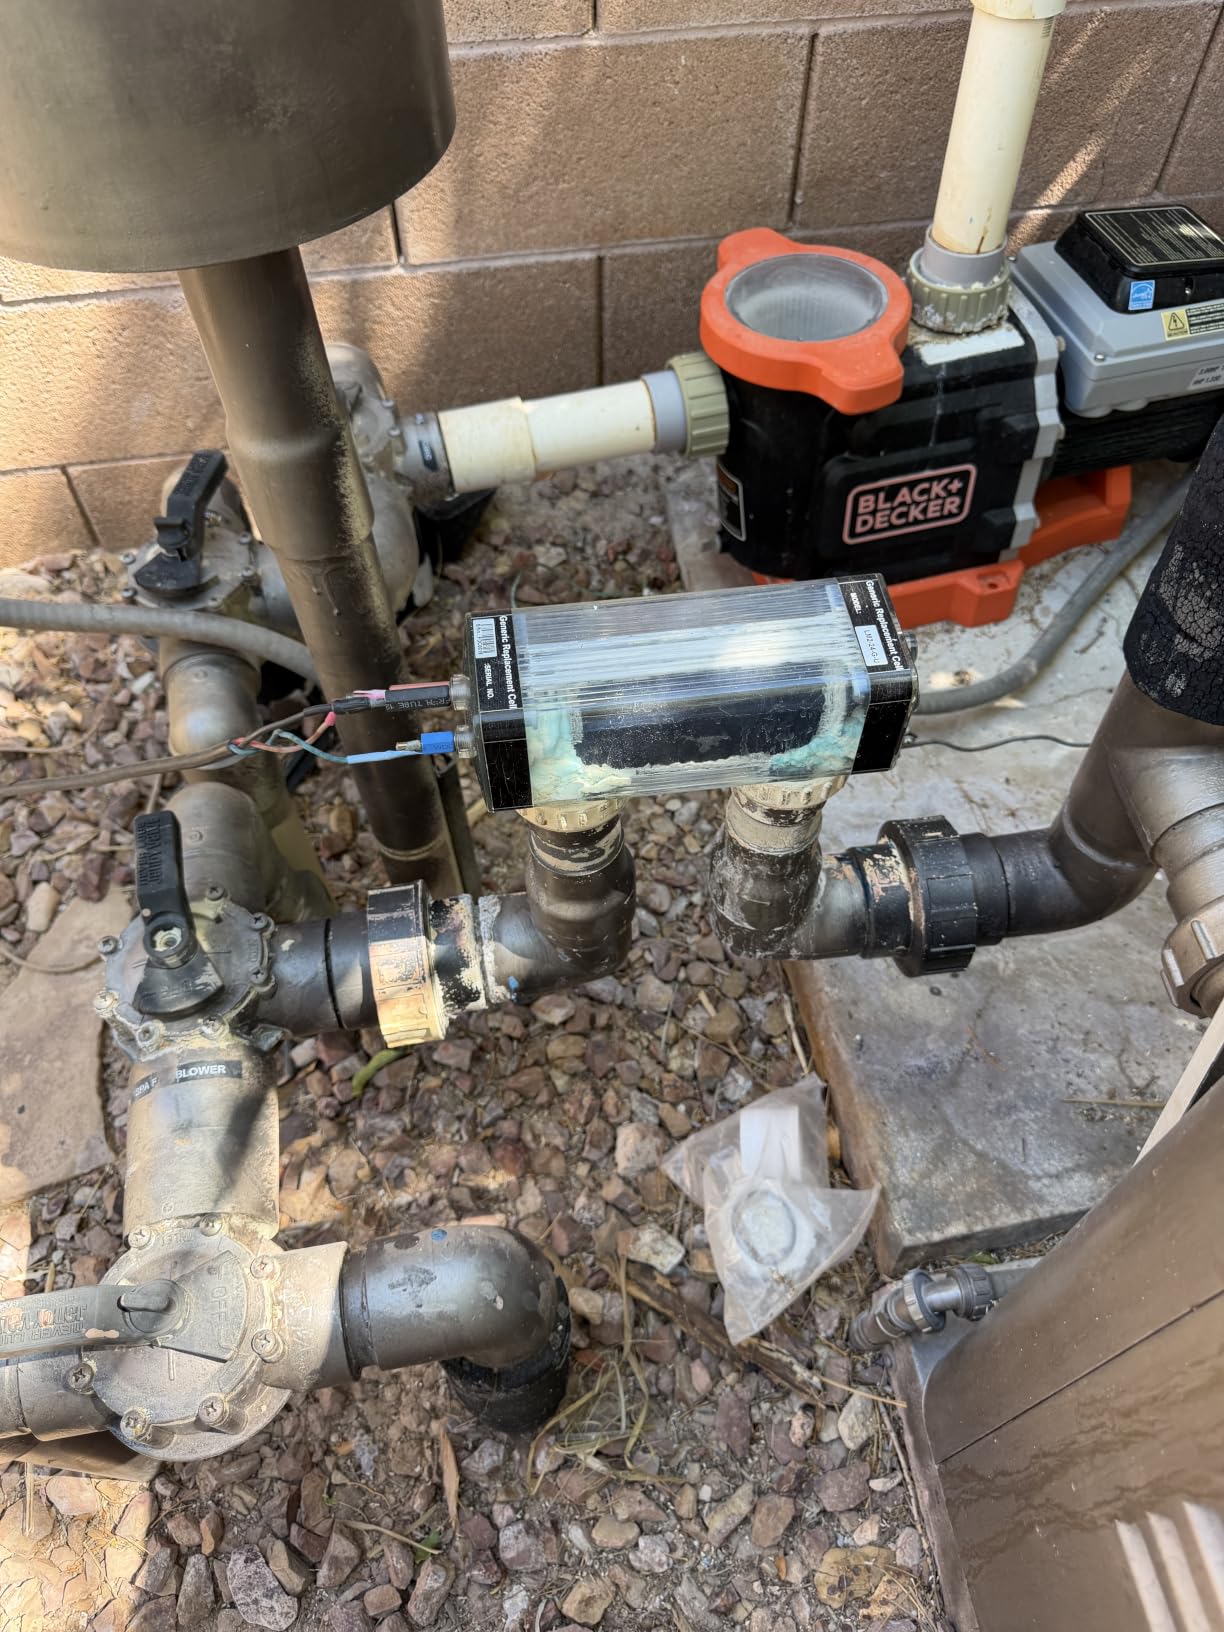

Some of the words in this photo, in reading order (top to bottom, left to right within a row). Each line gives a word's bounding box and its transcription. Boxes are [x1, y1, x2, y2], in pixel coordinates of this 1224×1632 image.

[857, 478, 963, 515] BLACK+
[855, 496, 961, 534] DECKER
[850, 592, 862, 614] MODEL:
[499, 615, 509, 643] Generic
[866, 580, 881, 608] Generic
[875, 607, 898, 656] Replacement
[892, 656, 905, 671] Cell
[484, 663, 493, 687] SERIAL
[501, 643, 516, 693] Replacement
[486, 688, 494, 699] NO.
[507, 693, 518, 709] Cell
[175, 1064, 227, 1080] BLOWER
